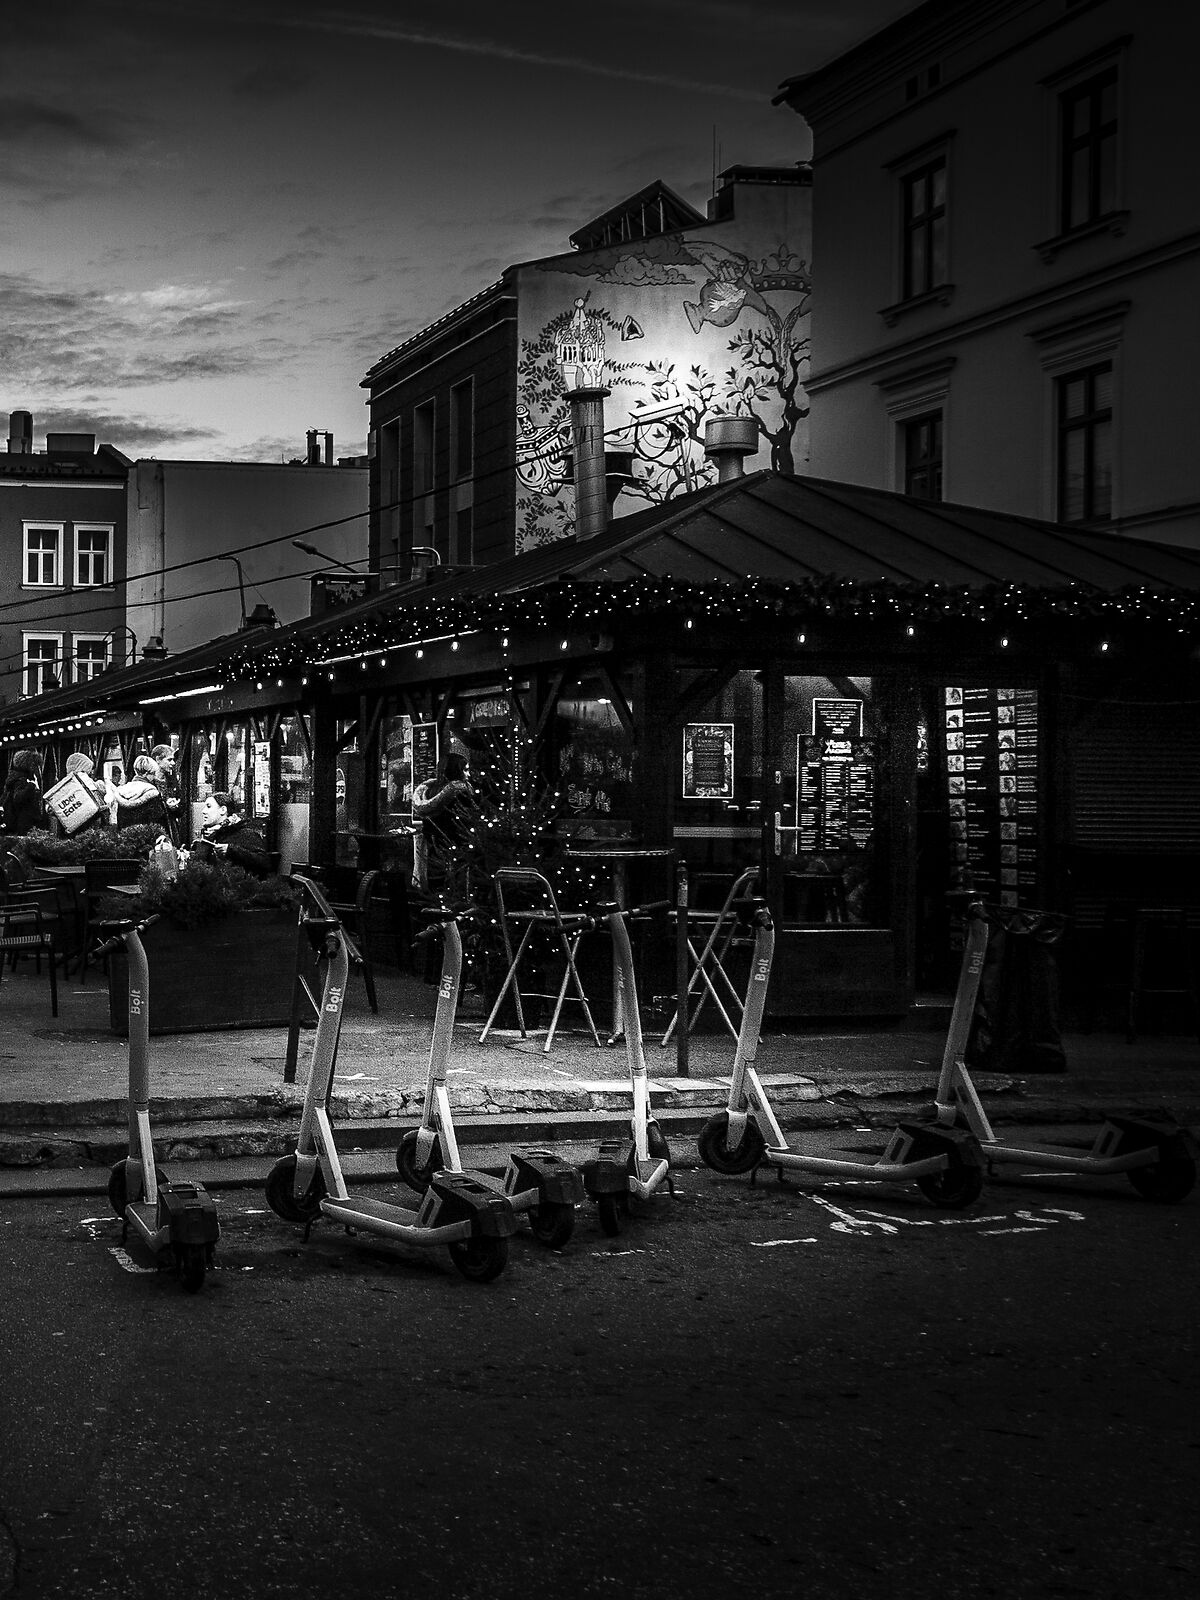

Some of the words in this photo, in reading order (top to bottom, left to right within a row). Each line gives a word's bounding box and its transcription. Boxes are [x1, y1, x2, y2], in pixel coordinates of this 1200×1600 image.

[58, 793, 77, 810] Uber
[62, 801, 83, 817] Eats
[754, 958, 770, 981] Bolt
[968, 951, 984, 974] Bolt
[440, 974, 455, 999] Bolt
[130, 989, 144, 1015] Bolt
[325, 986, 342, 1013] Bolt
